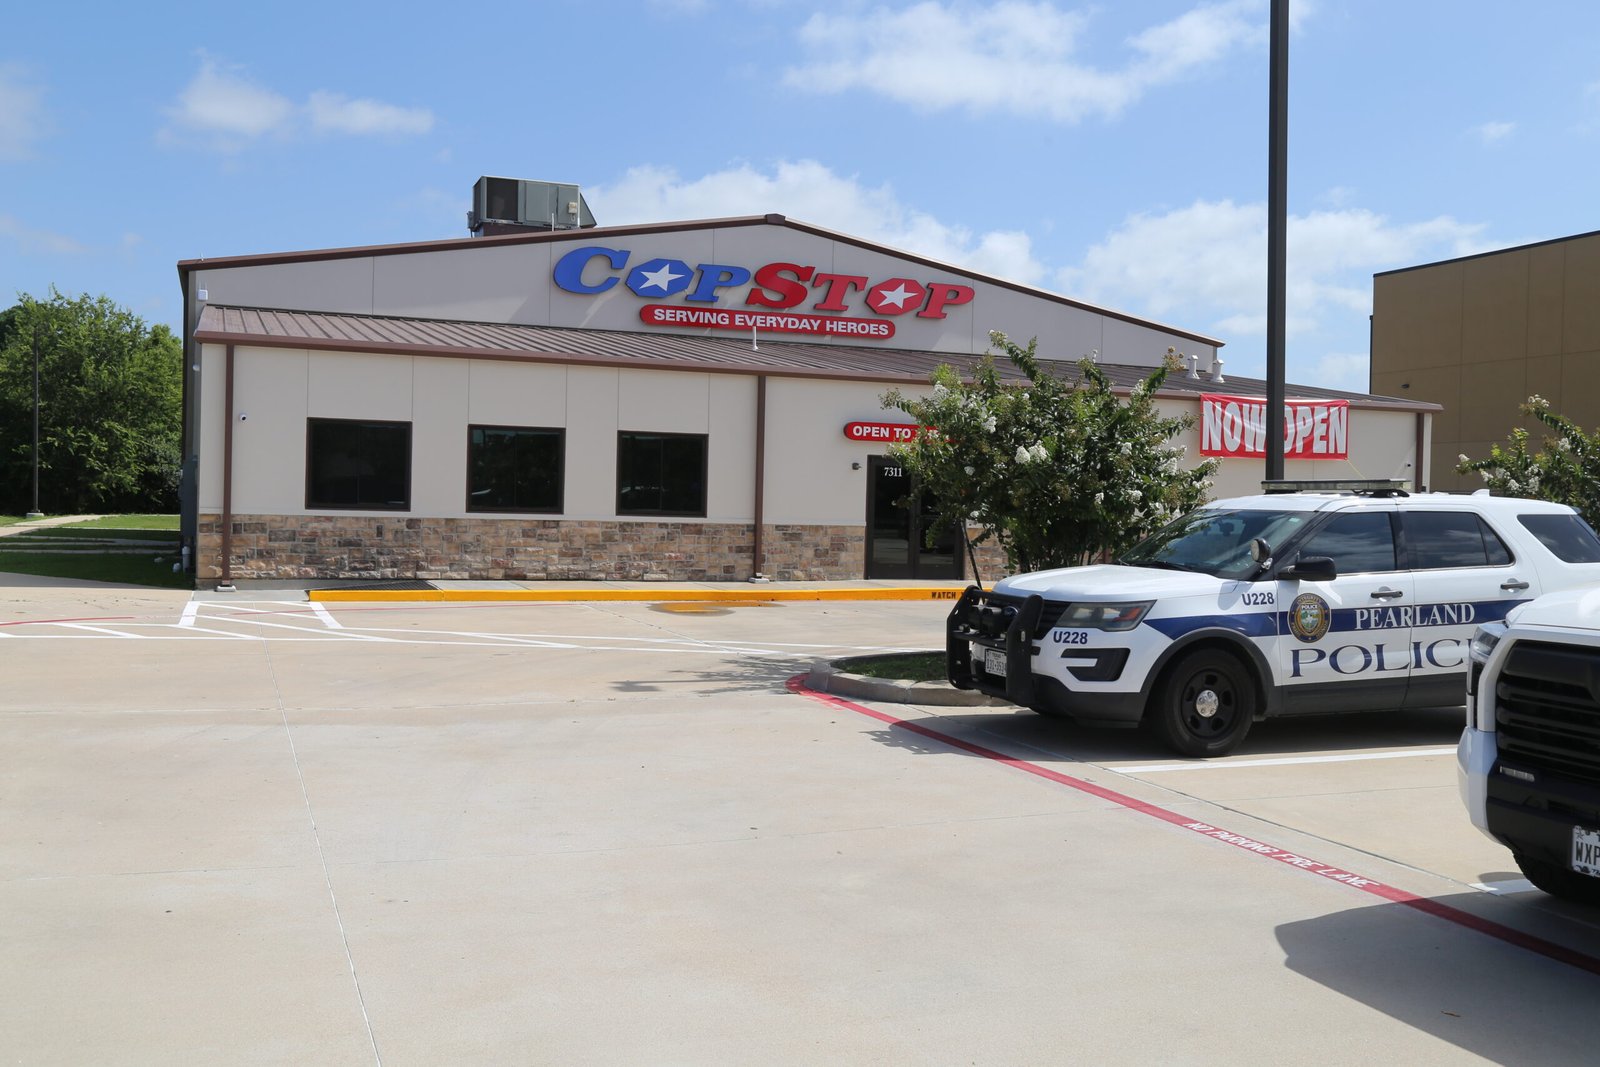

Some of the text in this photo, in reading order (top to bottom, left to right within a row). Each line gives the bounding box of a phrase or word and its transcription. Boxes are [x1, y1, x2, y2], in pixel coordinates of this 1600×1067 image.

[654, 308, 889, 336] SERVING EVERYDAY HEROES
[853, 426, 889, 438] OPEN
[894, 427, 911, 439] TO
[1202, 401, 1266, 452] NOW
[884, 467, 902, 477] 7311
[931, 591, 956, 600] WATCH
[1242, 591, 1275, 606] U228
[1355, 603, 1475, 630] PEARLAND
[1053, 631, 1088, 645] U228
[1289, 638, 1471, 678] POLIC
[1207, 831, 1280, 855] PARKING
[1272, 853, 1324, 868] FIRE
[1316, 868, 1380, 888] LANE
